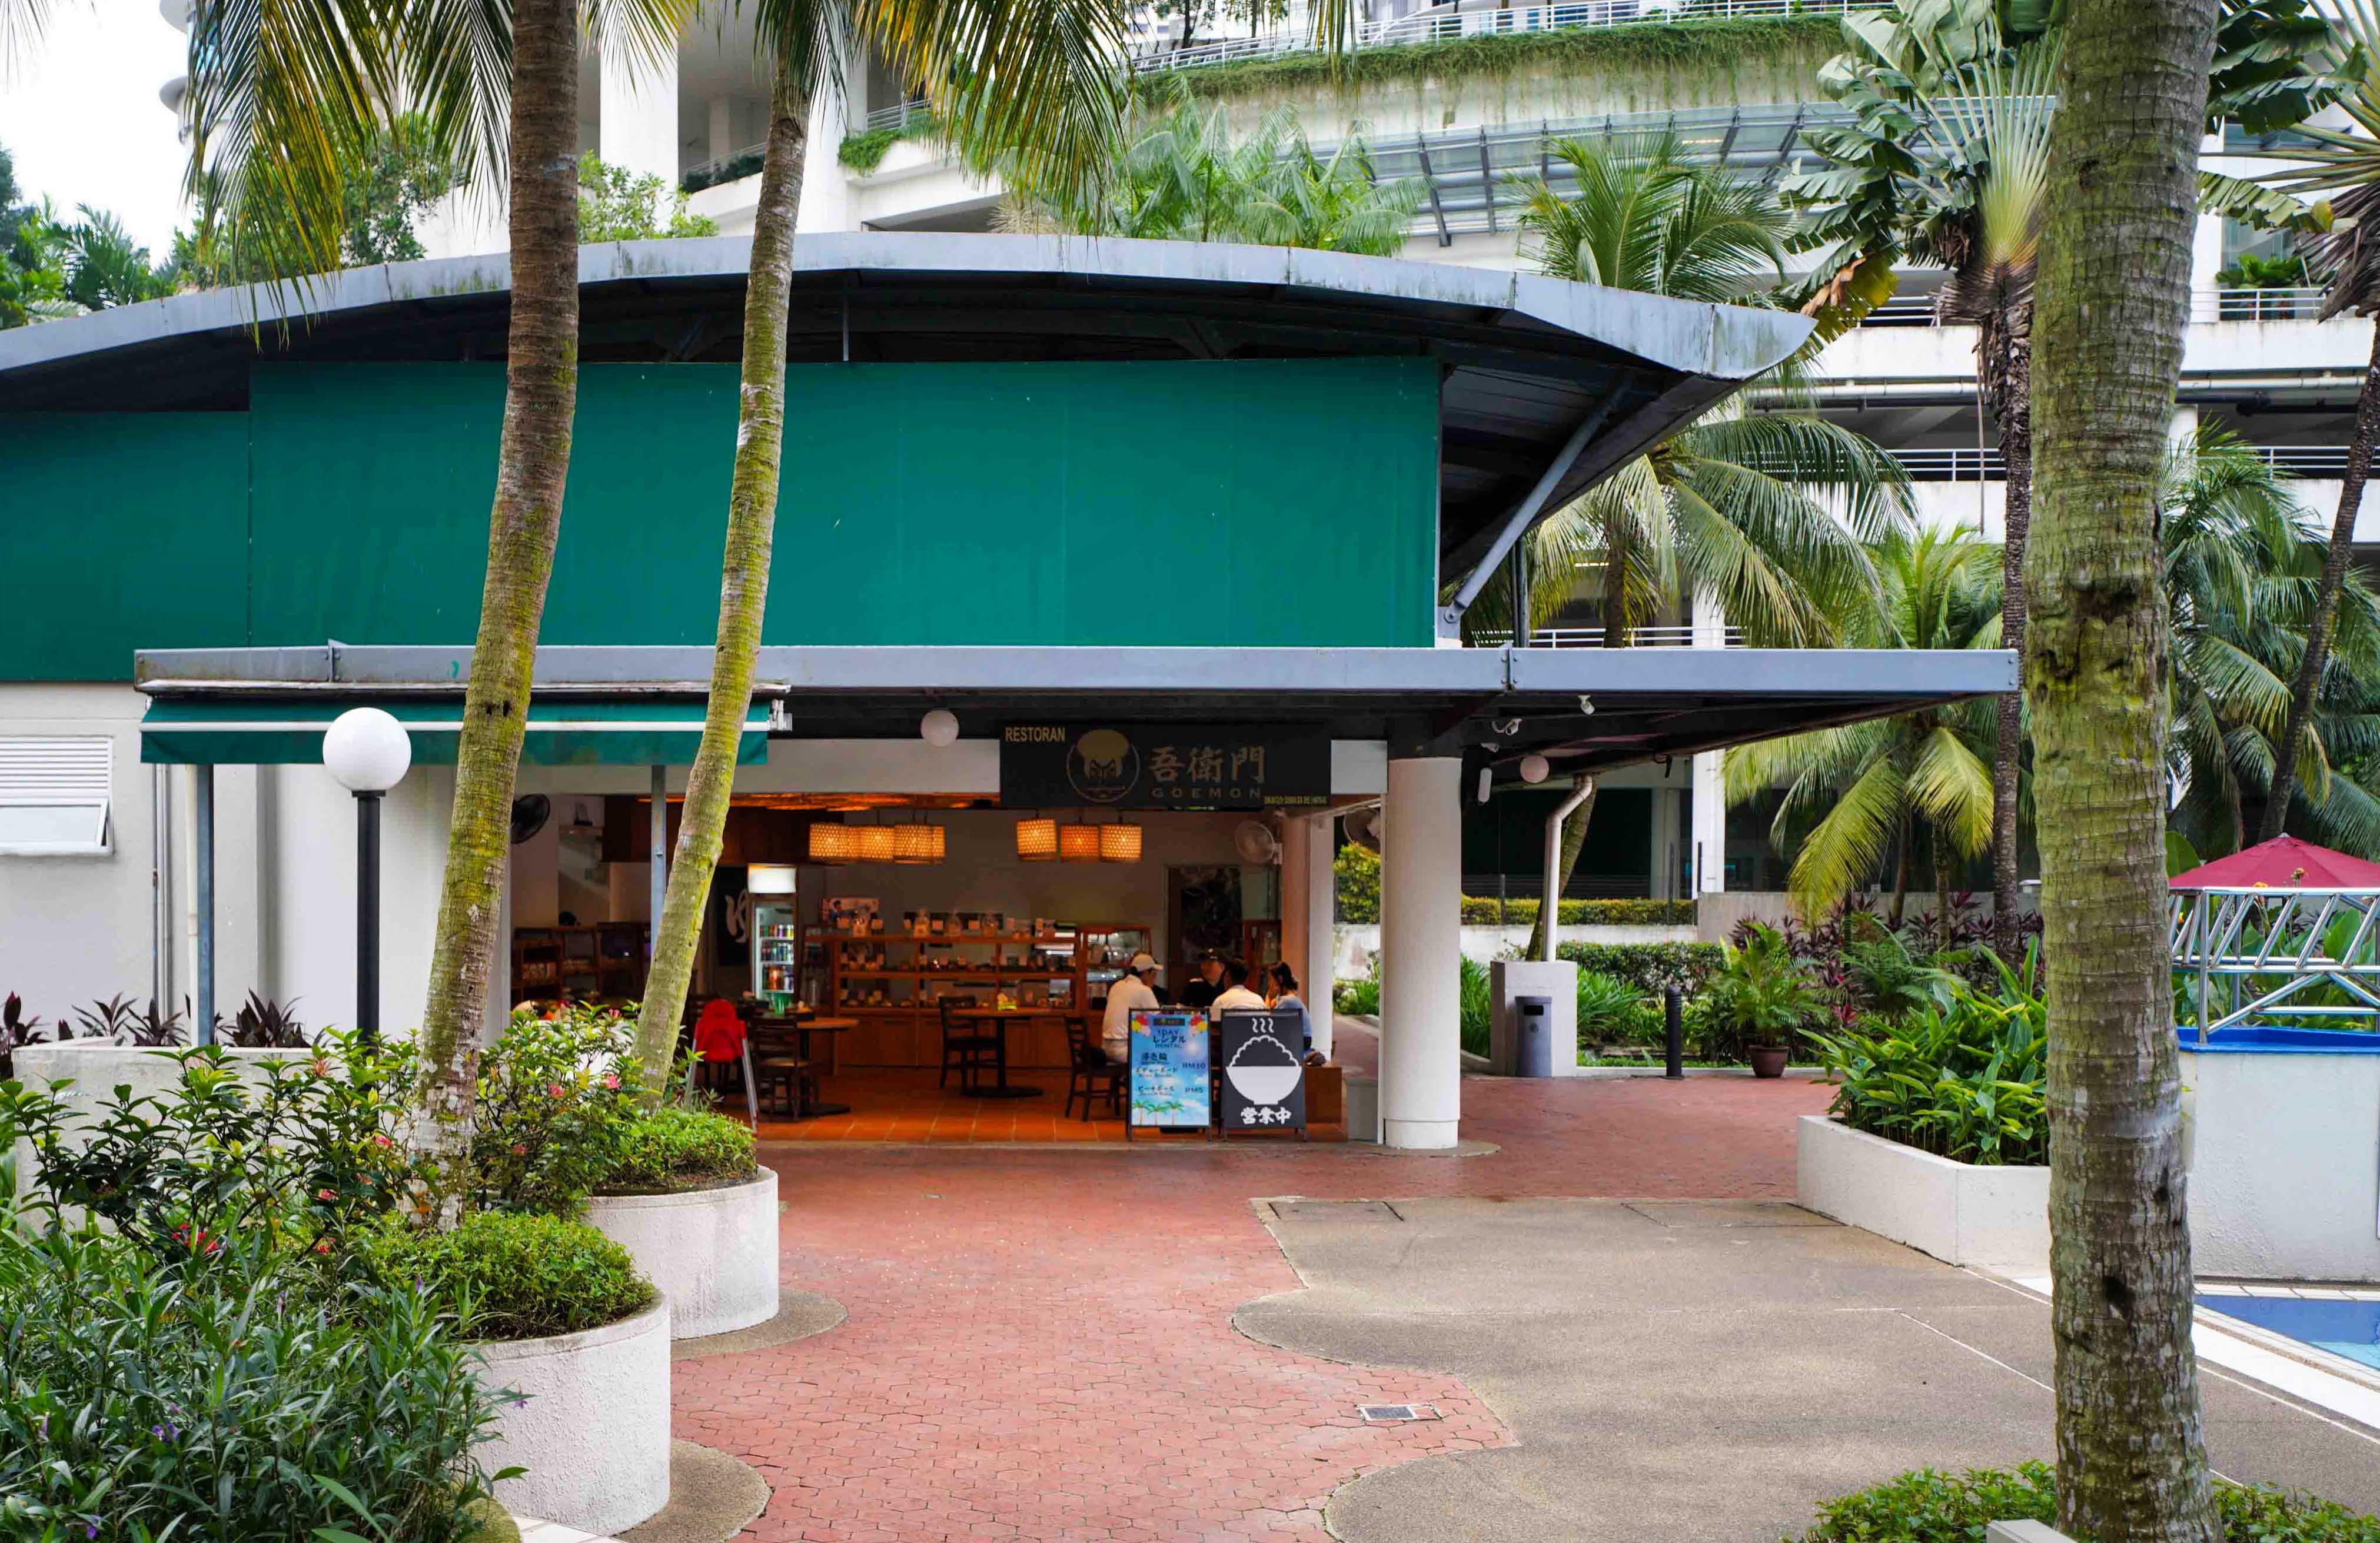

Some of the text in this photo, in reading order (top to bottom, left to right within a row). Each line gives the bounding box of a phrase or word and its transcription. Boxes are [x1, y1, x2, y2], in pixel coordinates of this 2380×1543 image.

[1005, 727, 1065, 742] RESTORAN
[1152, 787, 1261, 799] GOEMON
[1153, 1035, 1186, 1043] レンタル
